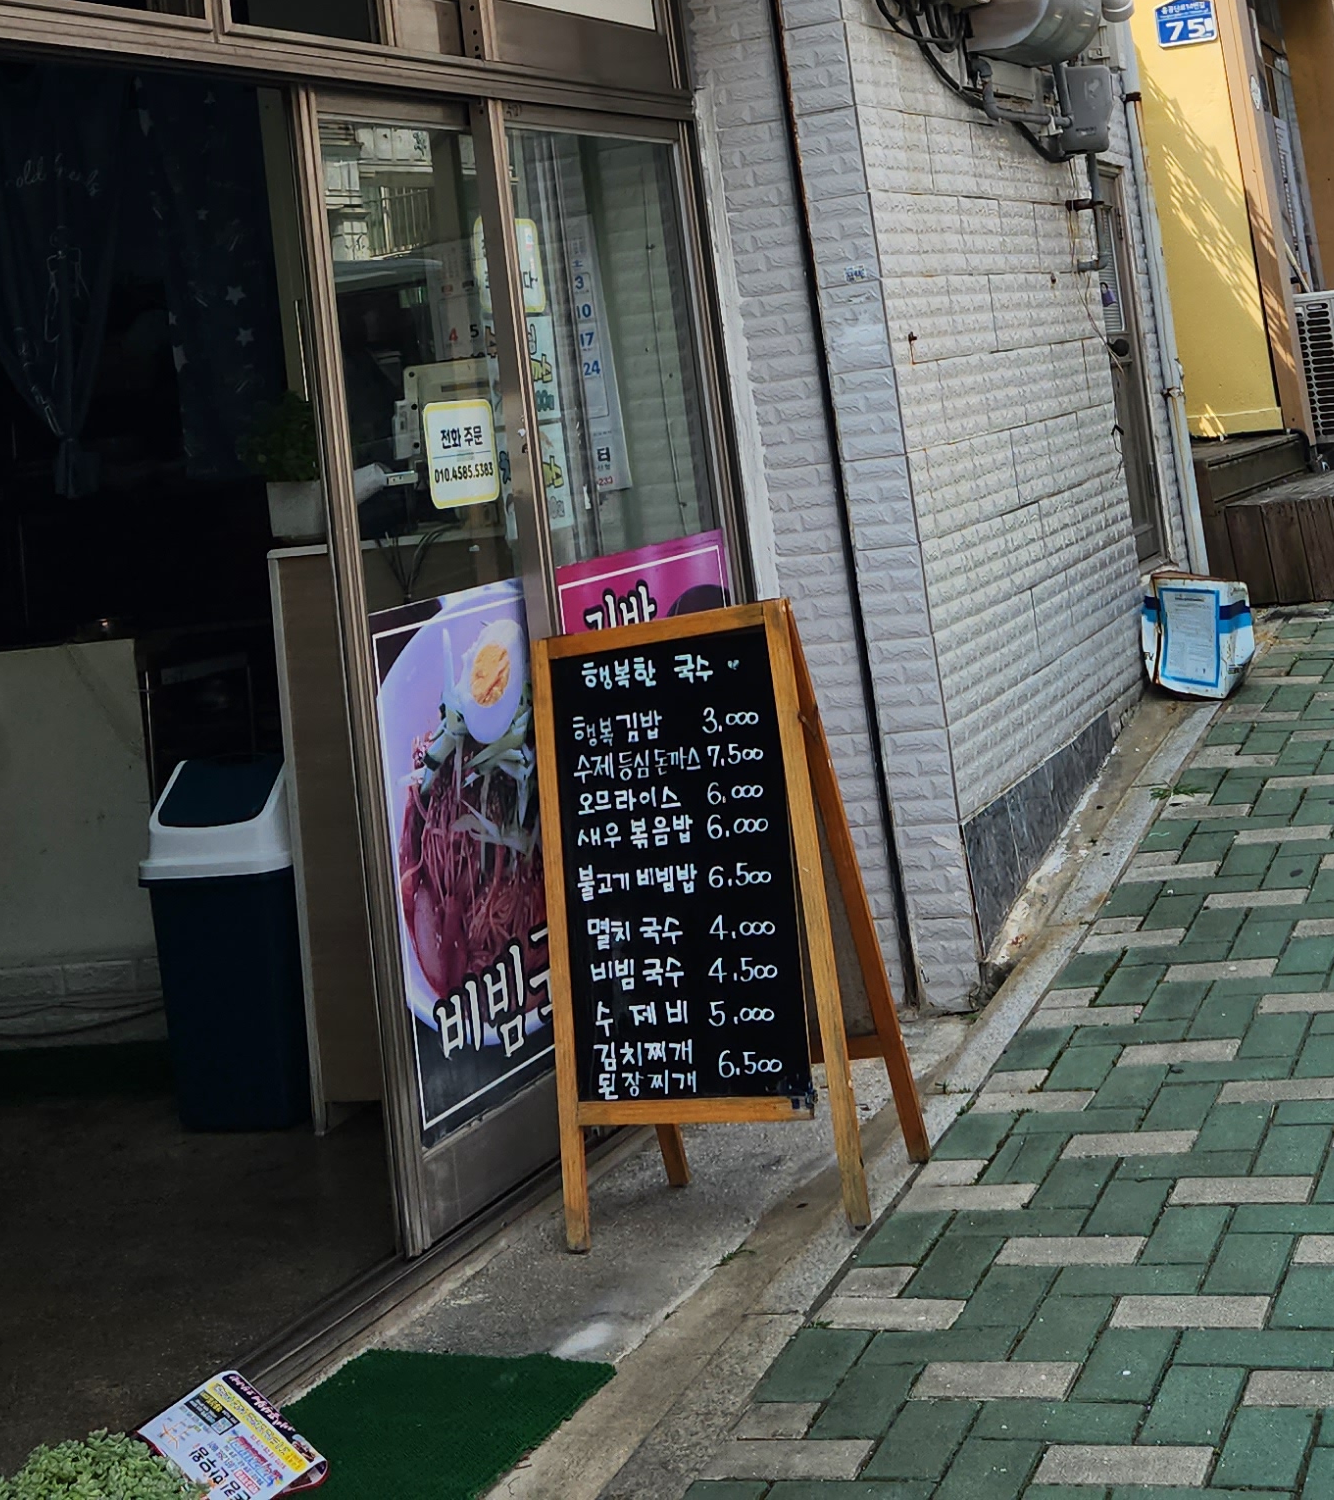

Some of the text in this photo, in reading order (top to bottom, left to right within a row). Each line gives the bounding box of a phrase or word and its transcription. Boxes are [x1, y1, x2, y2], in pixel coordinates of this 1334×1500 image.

[574, 275, 585, 290] 3
[469, 324, 480, 338] 5
[579, 331, 595, 348] 17
[583, 359, 601, 376] 24
[440, 425, 484, 450] 전화 주문
[434, 462, 494, 484] 010.4585.5383
[581, 653, 714, 689] 행복한 국수
[578, 785, 682, 815] 오므라이스
[639, 916, 684, 945] 국수
[593, 1038, 694, 1072] 김치찌개
[598, 1068, 698, 1100] 된장찌개
